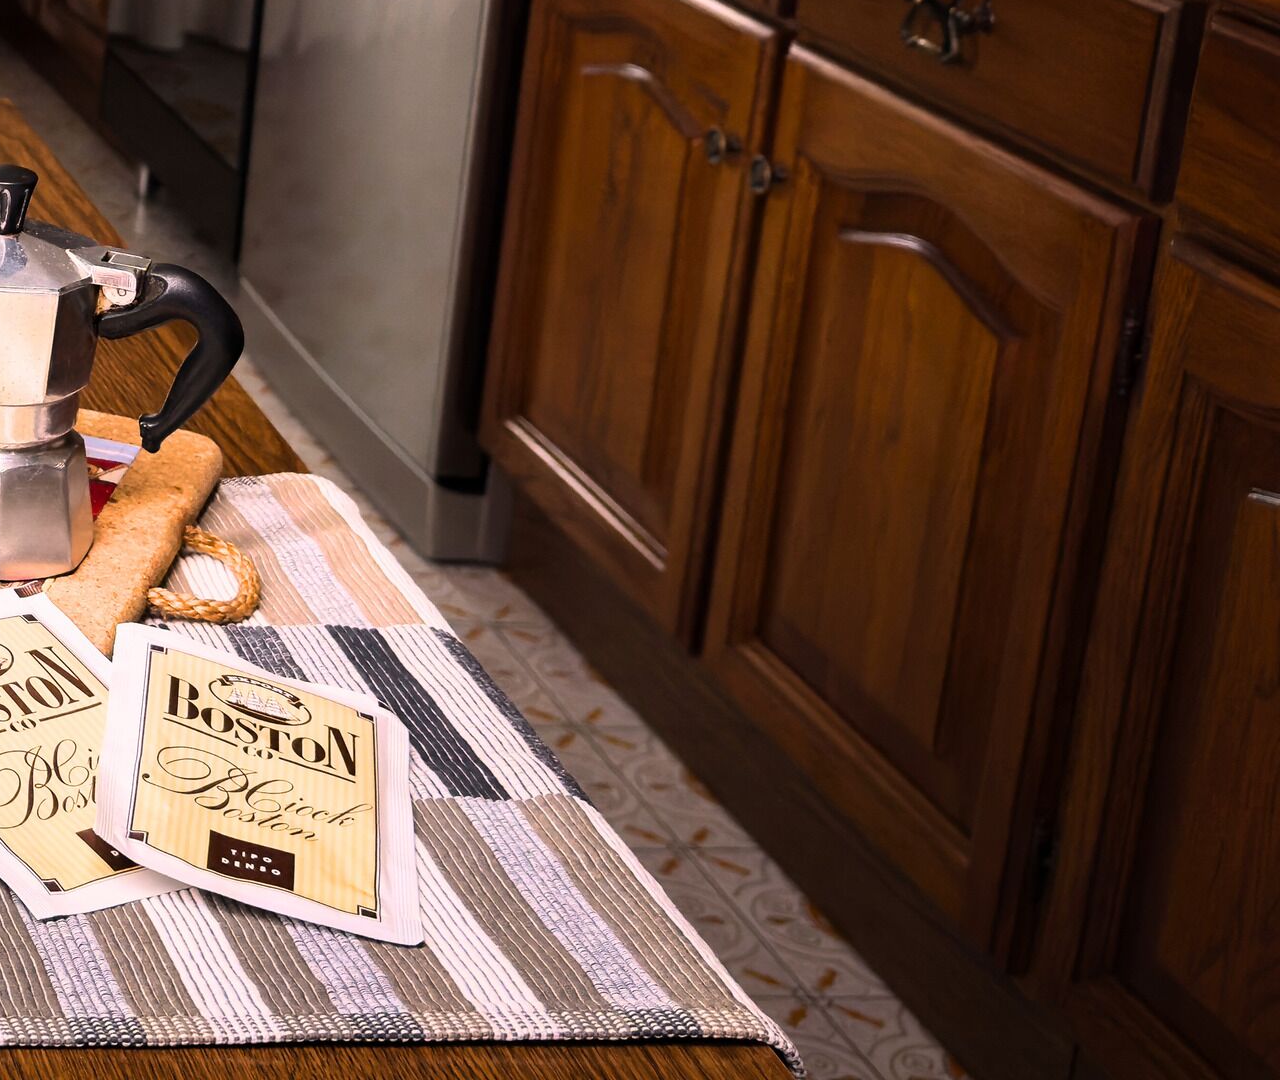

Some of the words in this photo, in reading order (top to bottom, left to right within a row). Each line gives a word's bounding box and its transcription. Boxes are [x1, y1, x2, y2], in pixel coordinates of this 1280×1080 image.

[163, 674, 360, 777] BOSTON
[230, 848, 273, 863] TIPO
[221, 857, 281, 877] DENSO
